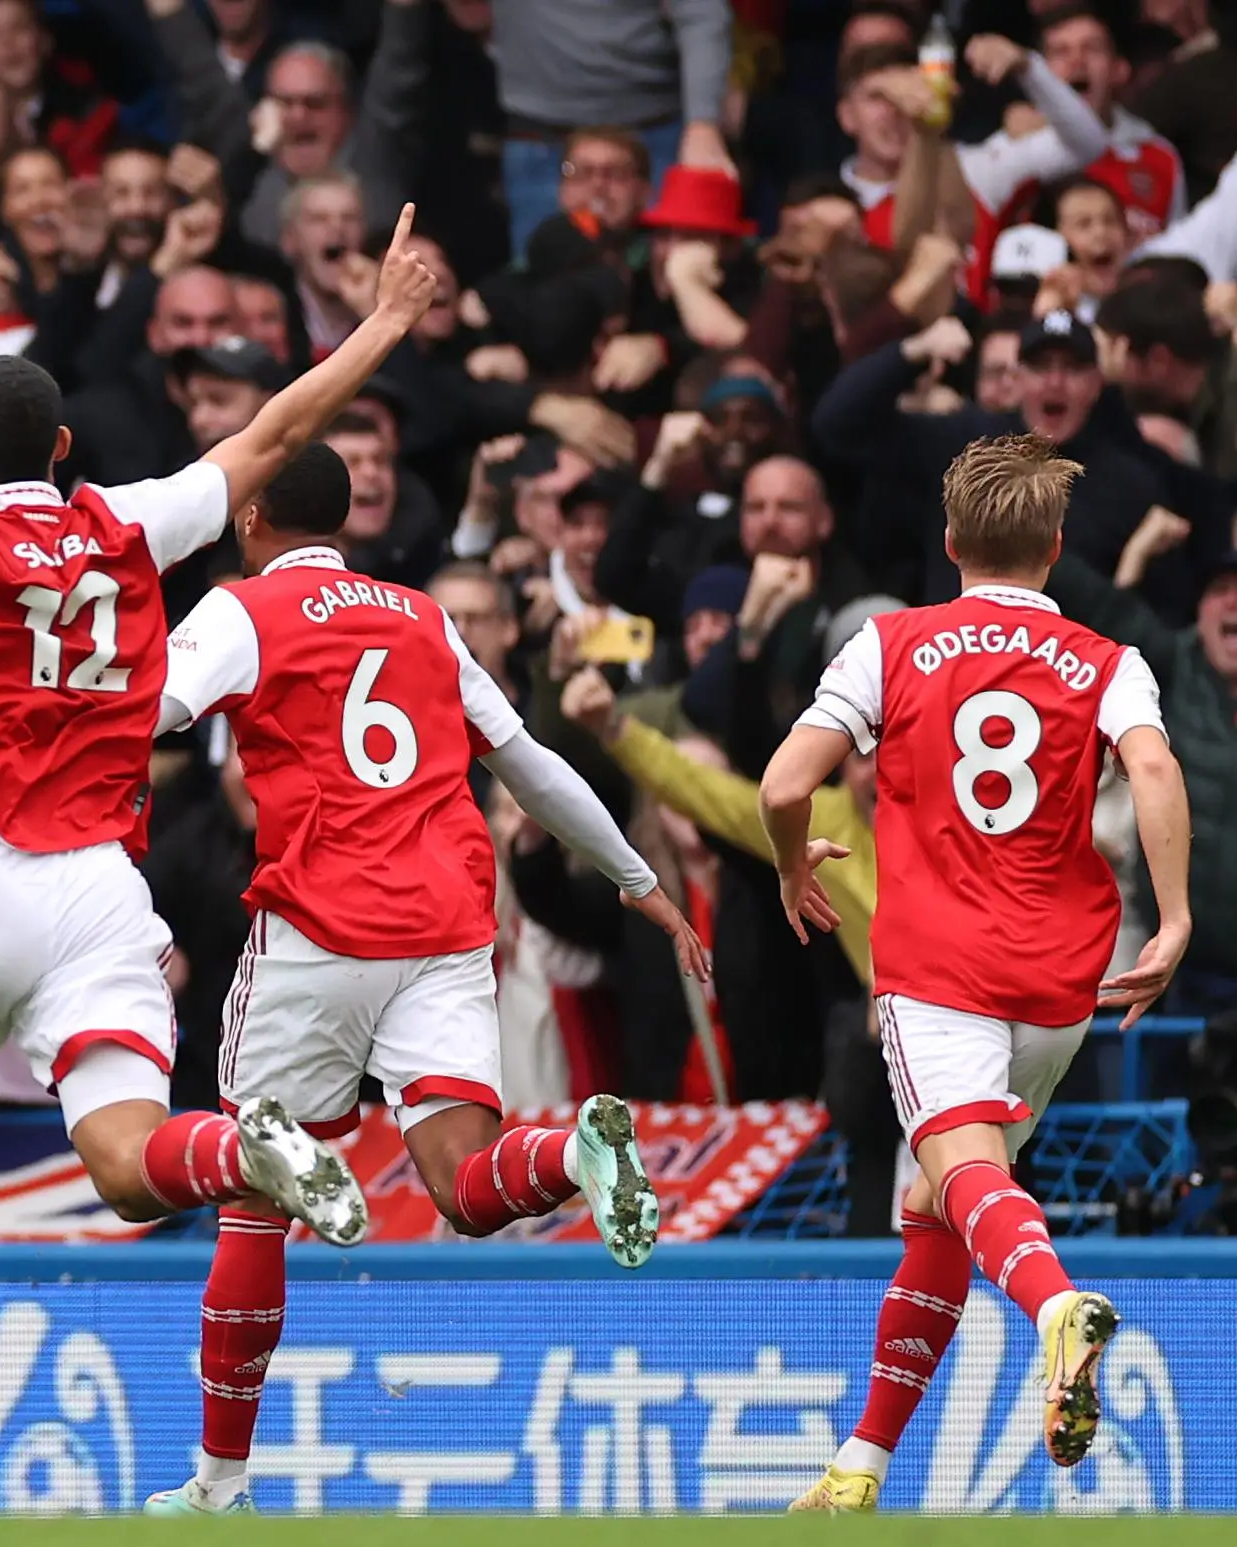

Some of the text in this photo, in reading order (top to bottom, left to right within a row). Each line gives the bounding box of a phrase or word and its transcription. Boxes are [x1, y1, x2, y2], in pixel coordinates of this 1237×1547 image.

[15, 570, 133, 692] 12
[301, 580, 419, 624] GABRIEL
[912, 623, 1098, 691] ØDEGAARD
[341, 648, 418, 789] 6
[952, 690, 1041, 836] 8
